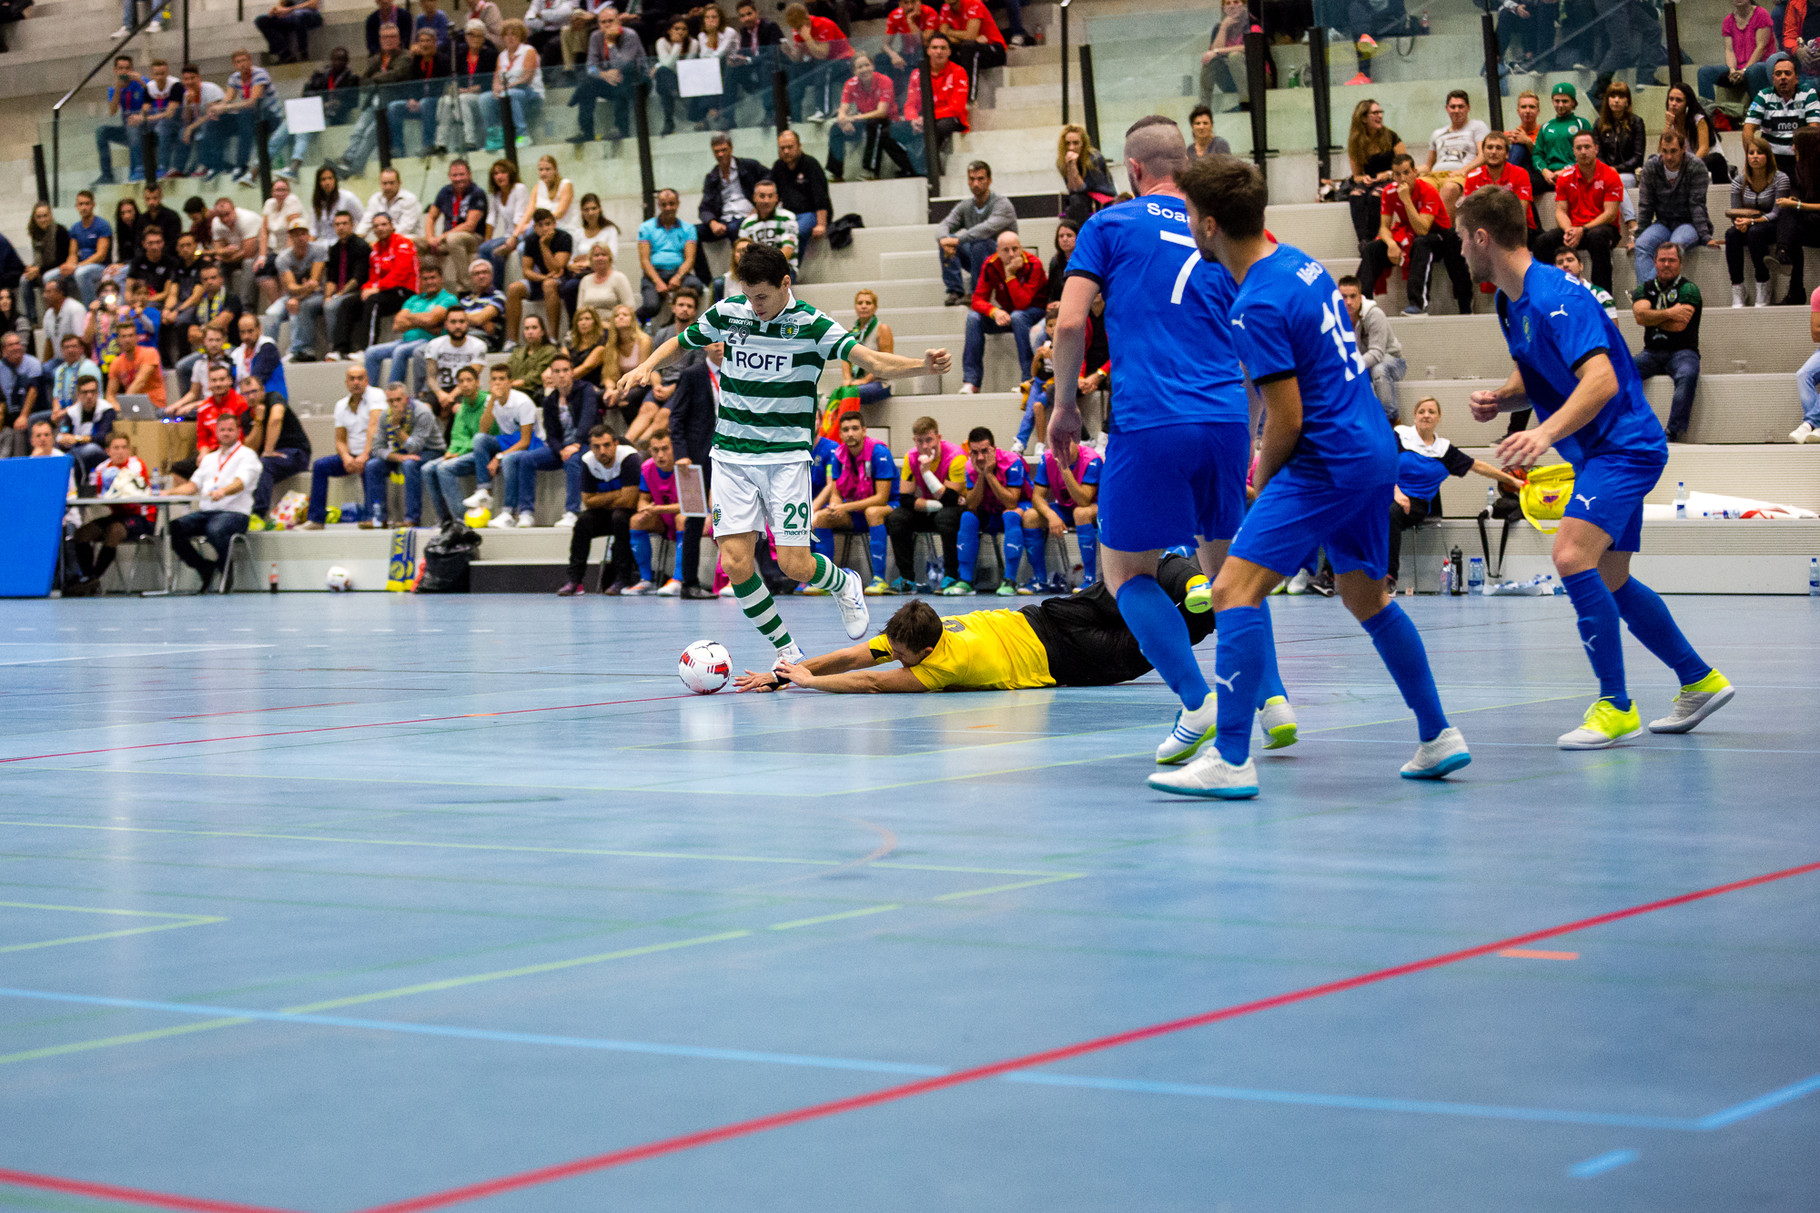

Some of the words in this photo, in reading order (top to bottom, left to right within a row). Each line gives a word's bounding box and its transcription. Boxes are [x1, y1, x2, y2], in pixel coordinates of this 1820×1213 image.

[1777, 122, 1798, 130] meo
[1159, 229, 1202, 305] 7
[727, 324, 750, 345] 29
[735, 350, 788, 372] ROFF
[783, 502, 809, 529] 29
